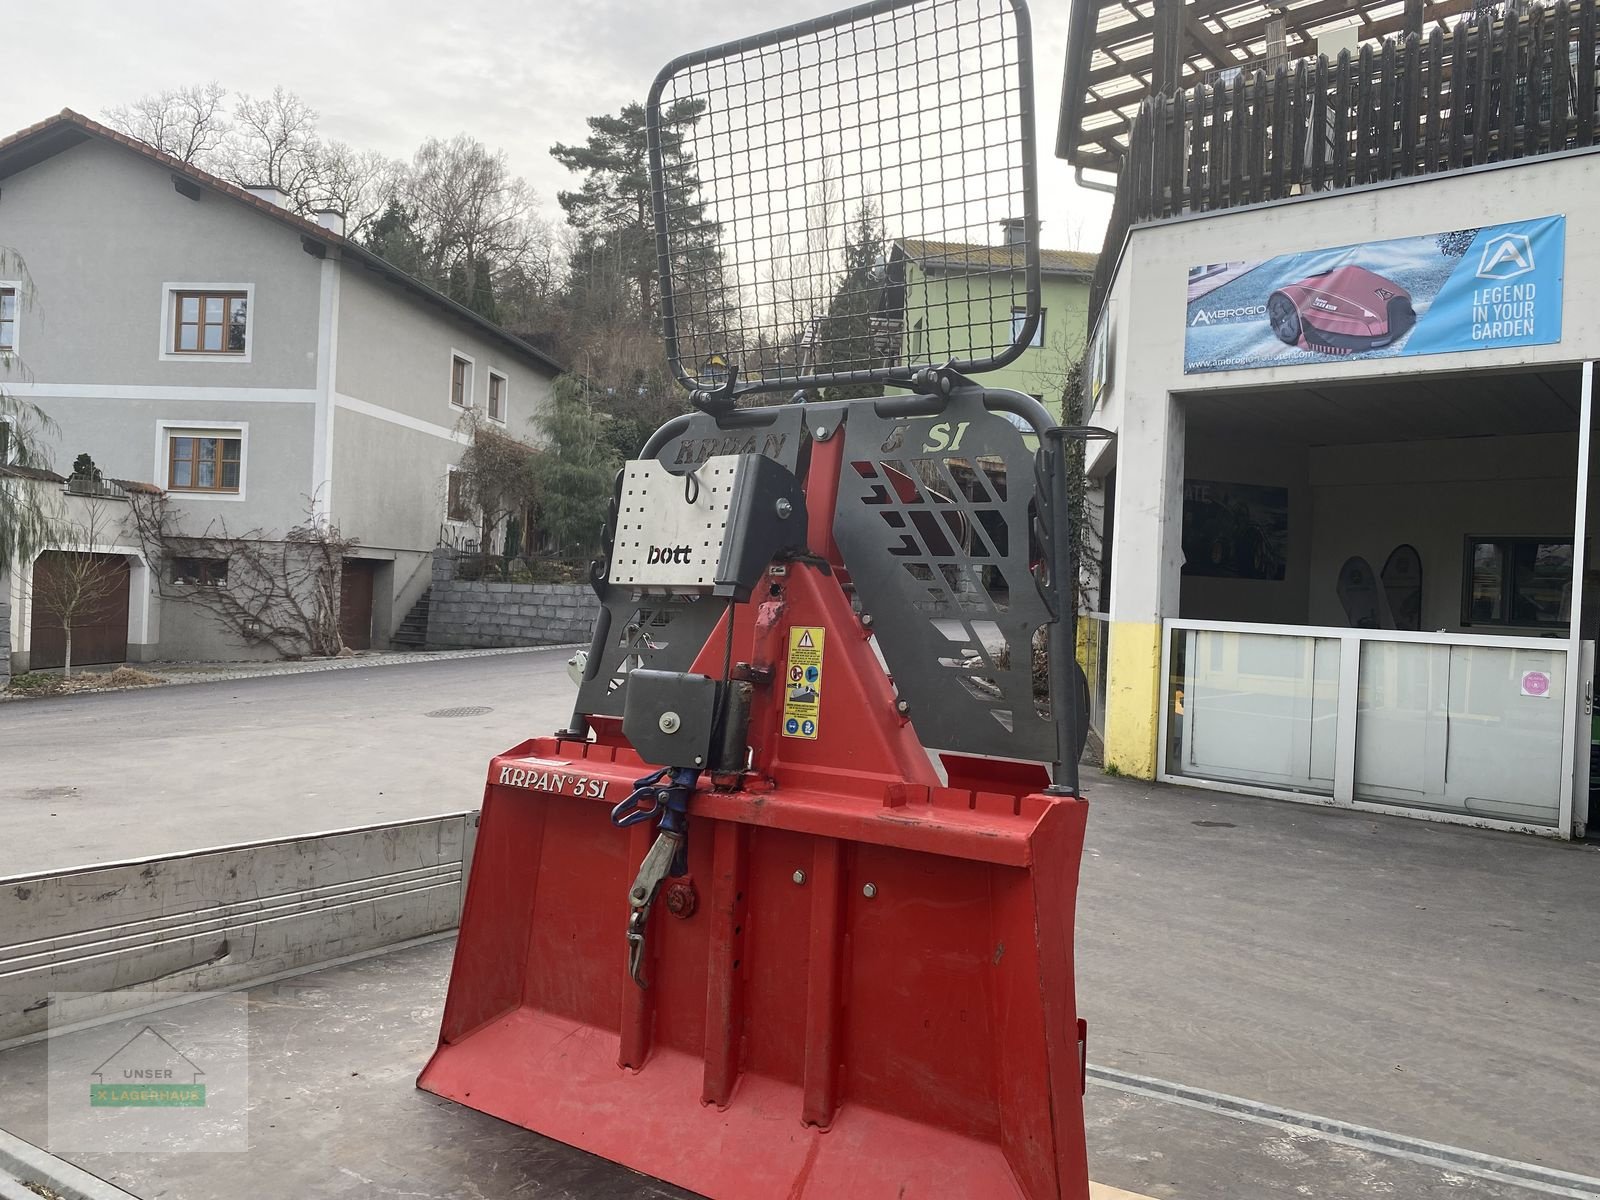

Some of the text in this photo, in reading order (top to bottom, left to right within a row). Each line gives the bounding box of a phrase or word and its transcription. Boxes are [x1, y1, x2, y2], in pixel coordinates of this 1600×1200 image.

[1473, 284, 1536, 305] LEGEND
[1191, 305, 1267, 326] AMBROGIO
[1473, 302, 1534, 322] IN YOUR
[1472, 319, 1534, 340] GARDEN
[922, 422, 970, 453] SI
[673, 433, 790, 464] KRPAN
[647, 545, 692, 564] bott
